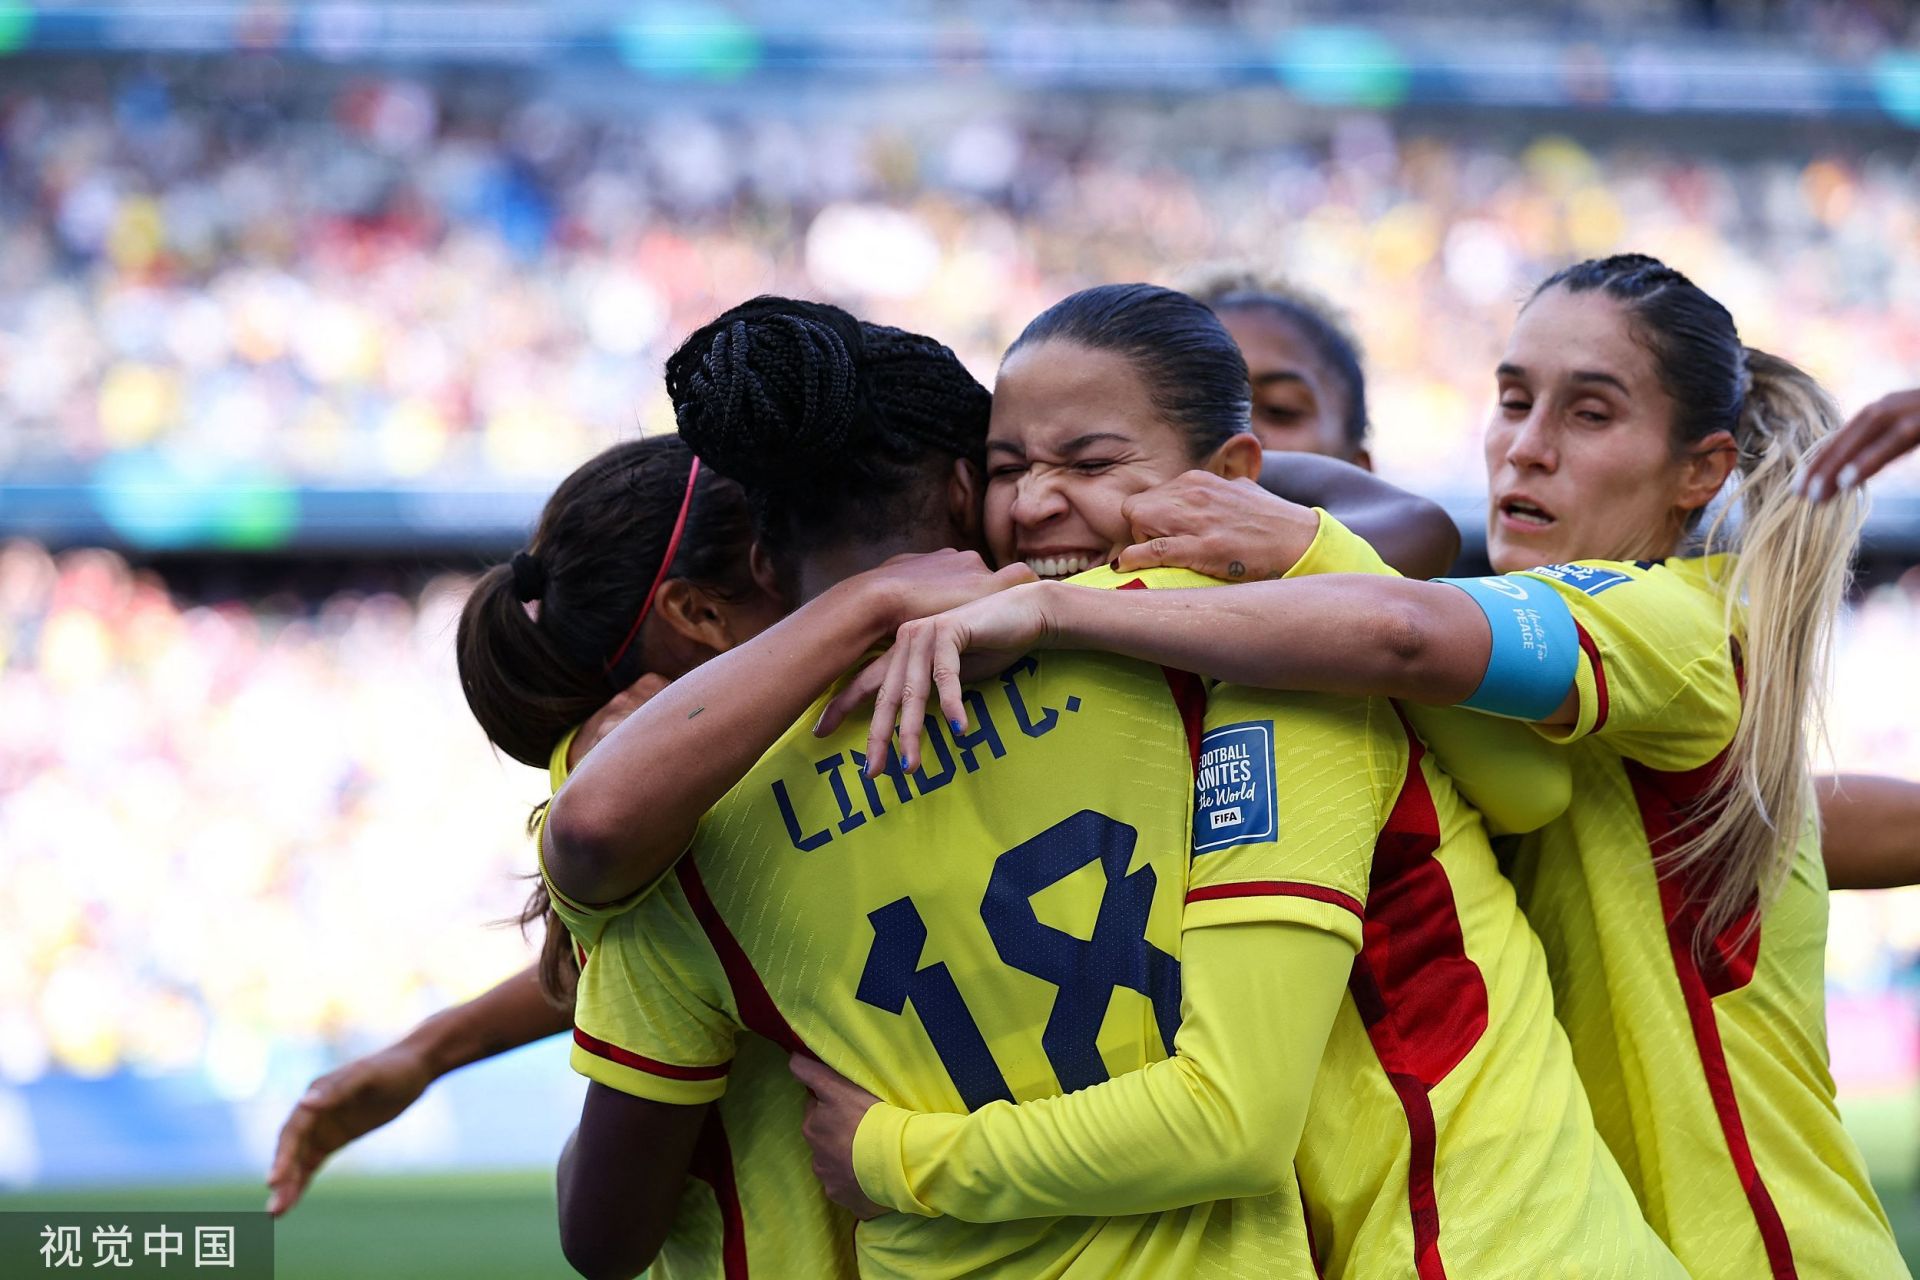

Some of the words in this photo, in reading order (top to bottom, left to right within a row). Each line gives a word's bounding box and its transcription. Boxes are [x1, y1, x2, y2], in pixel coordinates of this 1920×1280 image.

[1513, 608, 1535, 650] PEACE
[771, 690, 1007, 852] LINDA
[1000, 656, 1082, 738] C.
[1196, 760, 1251, 792] UNITES
[1198, 792, 1214, 812] the
[1215, 781, 1256, 806] World
[1214, 812, 1238, 825] FIFA
[855, 809, 1182, 1114] 18
